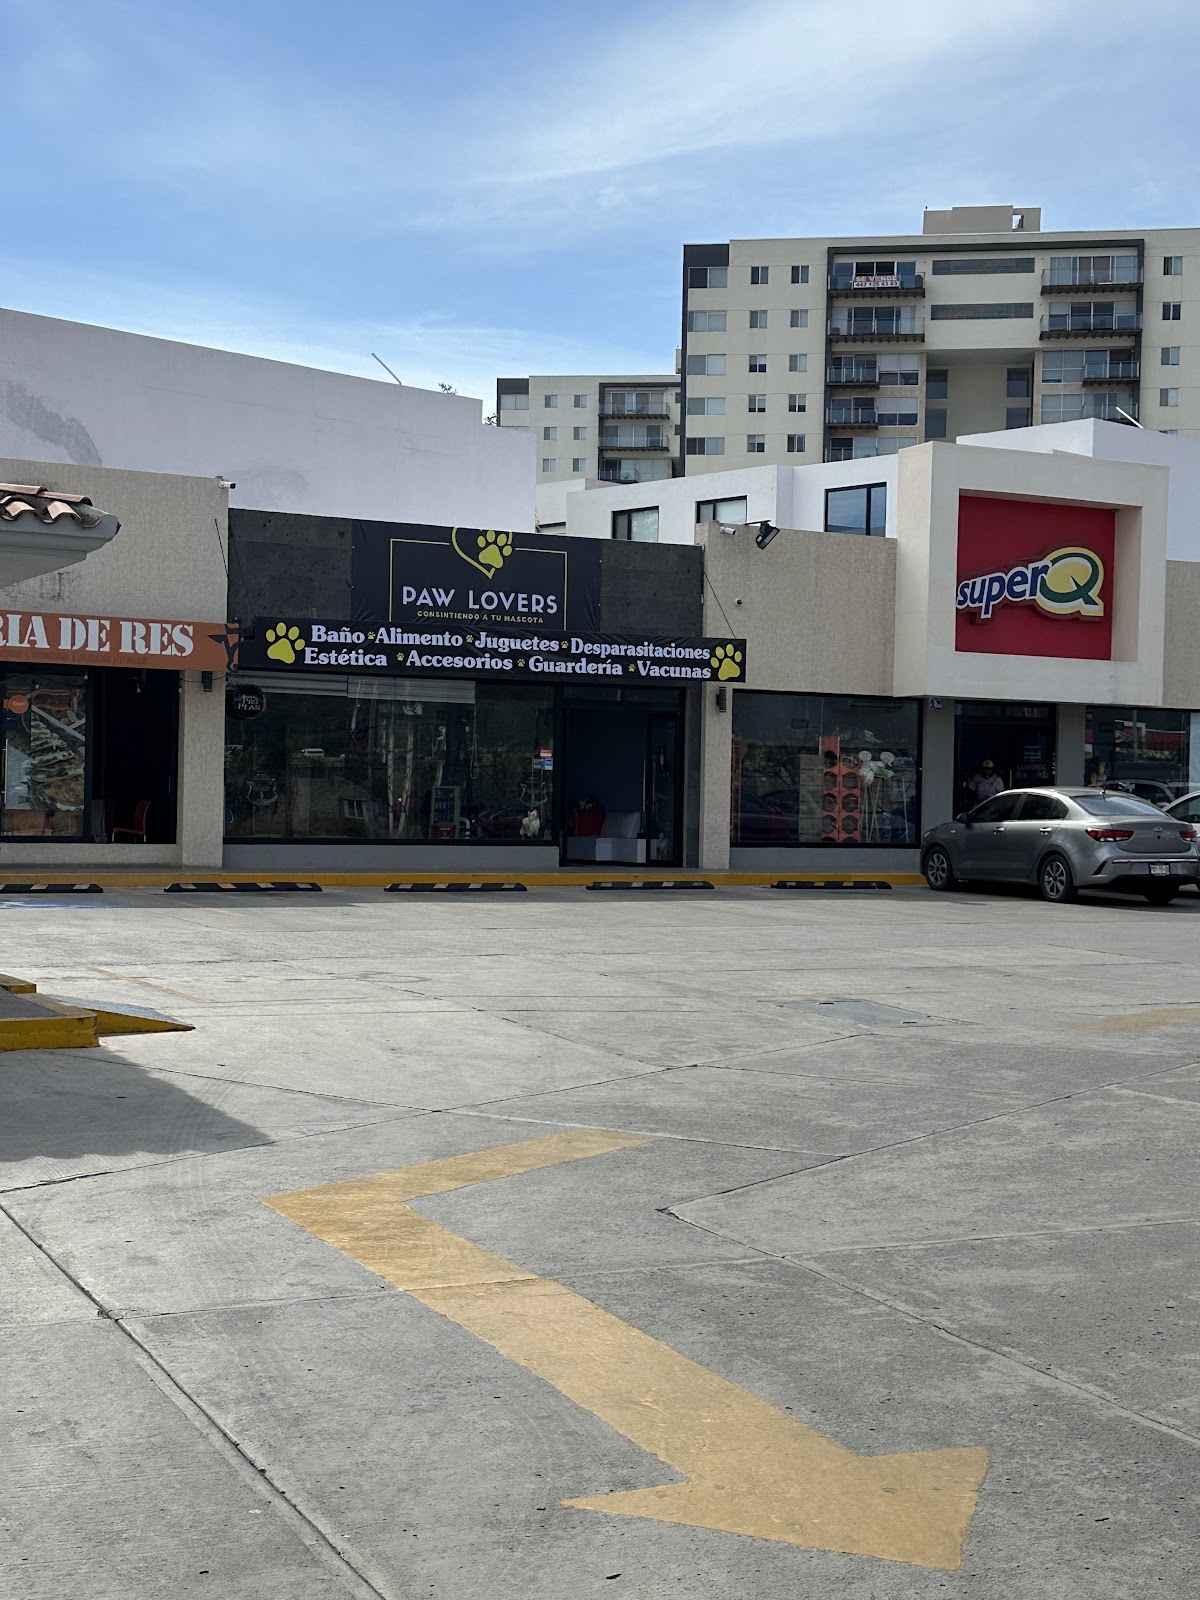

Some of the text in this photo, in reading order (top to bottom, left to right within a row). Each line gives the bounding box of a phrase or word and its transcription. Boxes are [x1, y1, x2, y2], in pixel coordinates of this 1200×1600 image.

[402, 586, 558, 614] PAW LOVERS
[417, 610, 480, 620] CONSINTIENDO
[491, 614, 502, 622] TU
[504, 615, 544, 624] MASCOTA
[0, 613, 194, 657] IA DE RES
[311, 625, 710, 660] Baño Alimento Juguetes Desparasitaciones
[304, 647, 712, 679] Estética Accesorios Guardería Vacunas
